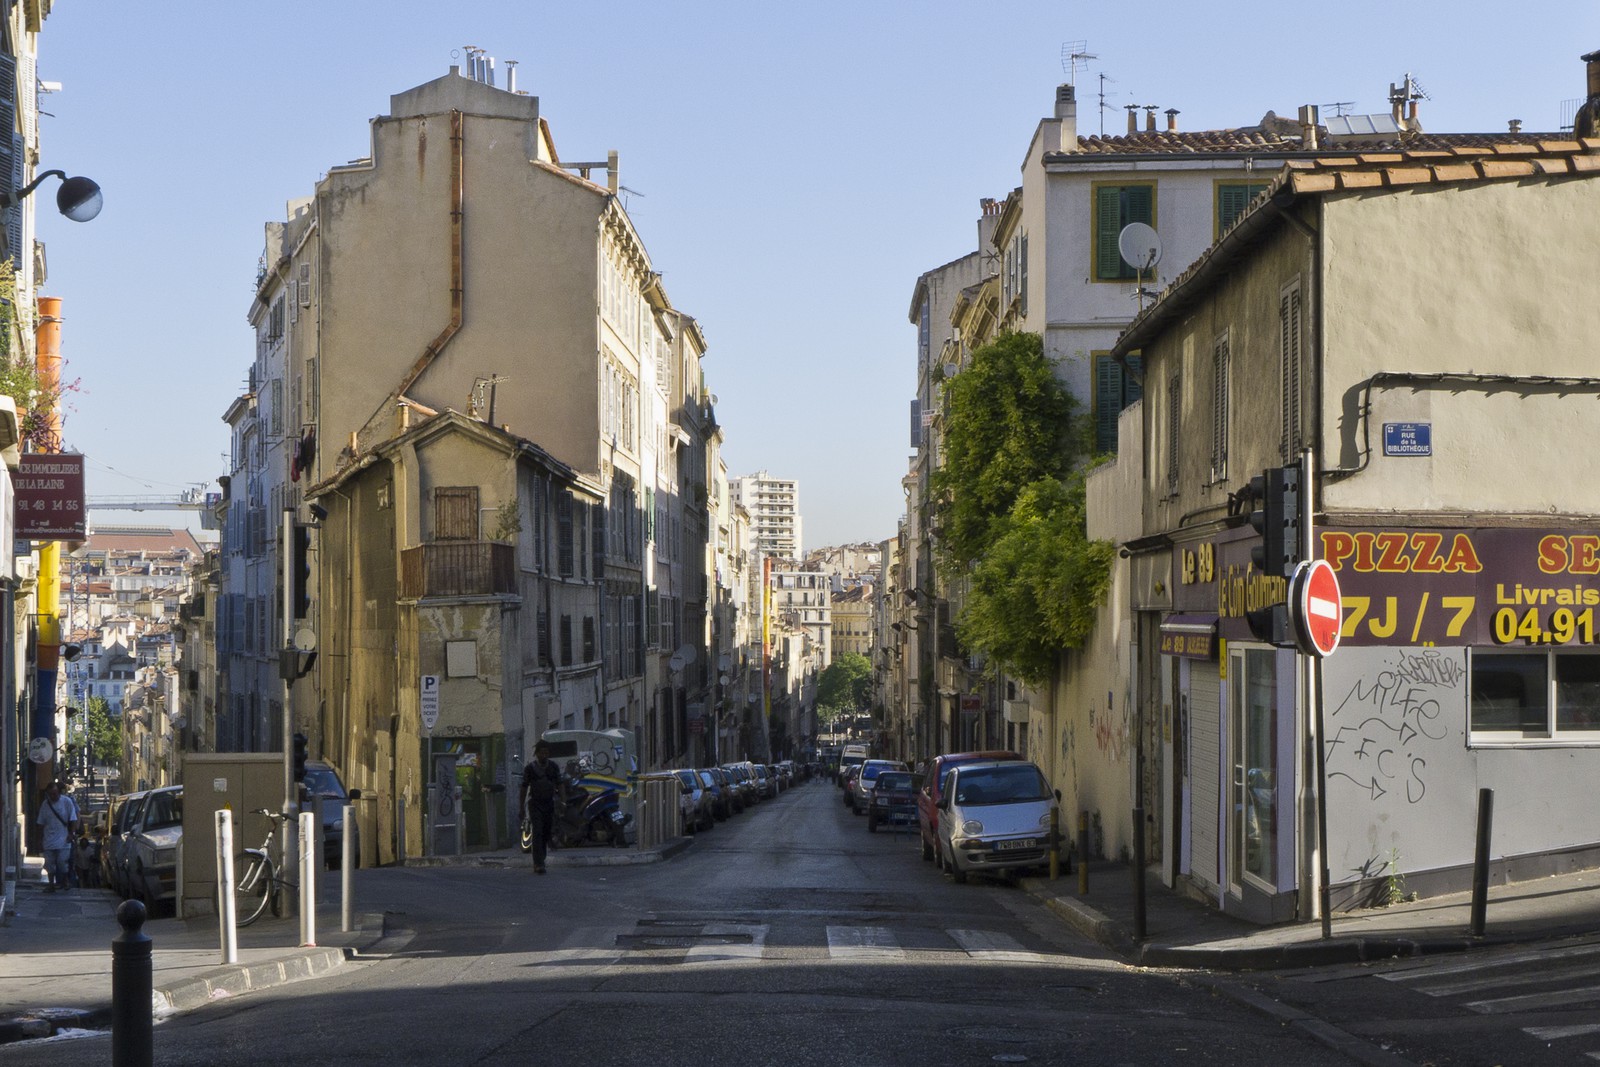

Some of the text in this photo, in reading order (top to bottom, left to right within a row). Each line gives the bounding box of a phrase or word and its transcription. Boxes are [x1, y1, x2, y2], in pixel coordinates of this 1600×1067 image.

[15, 479, 65, 489] DE LA PLAINE
[18, 500, 79, 510] 91 48 14 35
[1181, 542, 1214, 585] Le 89
[1320, 531, 1600, 574] PIZZA SE
[1218, 565, 1227, 617] Le
[1228, 563, 1245, 617] Coin
[1496, 584, 1600, 605] Livrais
[1442, 596, 1475, 637] 7
[1494, 607, 1594, 643] 04.91
[1161, 635, 1172, 651] Le
[1174, 635, 1184, 653] 89
[425, 677, 435, 689] P
